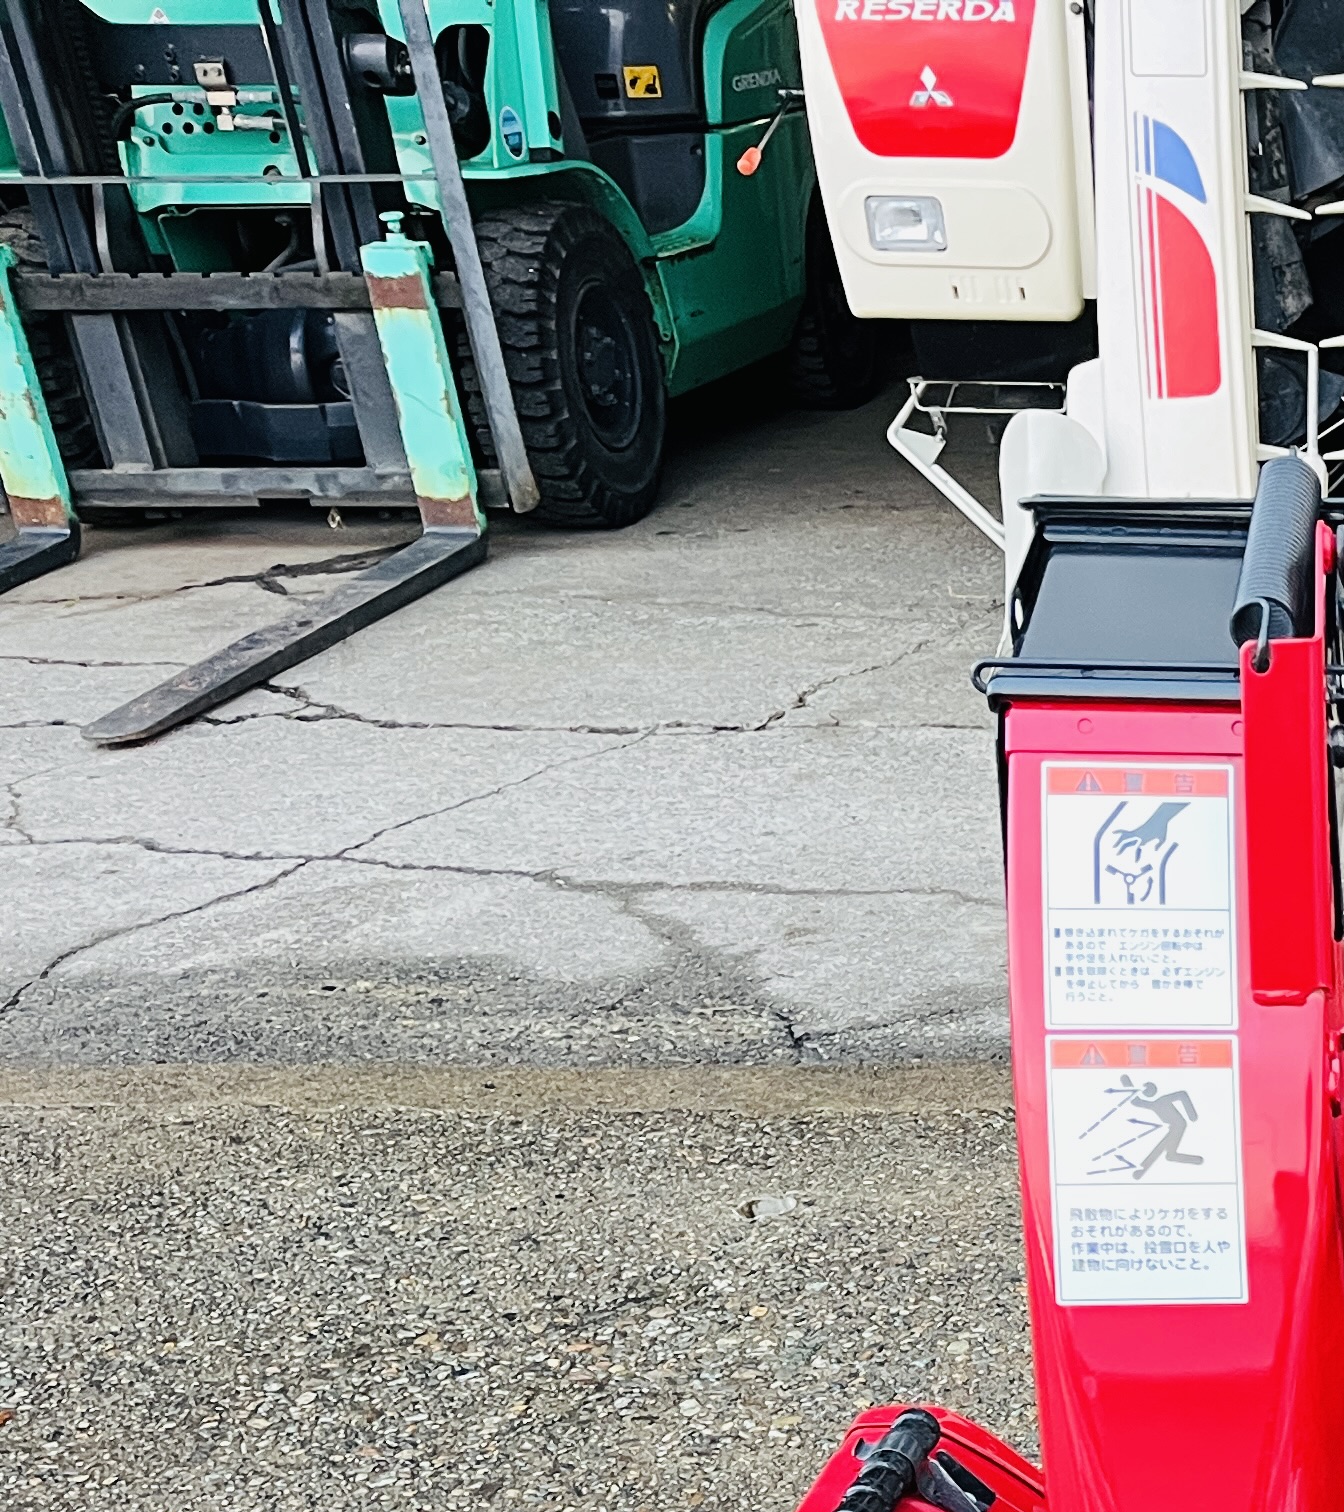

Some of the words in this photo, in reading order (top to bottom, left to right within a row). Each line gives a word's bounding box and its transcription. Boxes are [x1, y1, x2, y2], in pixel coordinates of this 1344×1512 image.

[834, 0, 1016, 22] RESERDA
[1070, 1207, 1228, 1222] 飛散物によりケガをする
[1071, 1224, 1193, 1238] おそれがあるので、
[1071, 1240, 1231, 1255] 作業中は、投雪口を人や
[1072, 1258, 1210, 1273] 建物に向けないこと。
